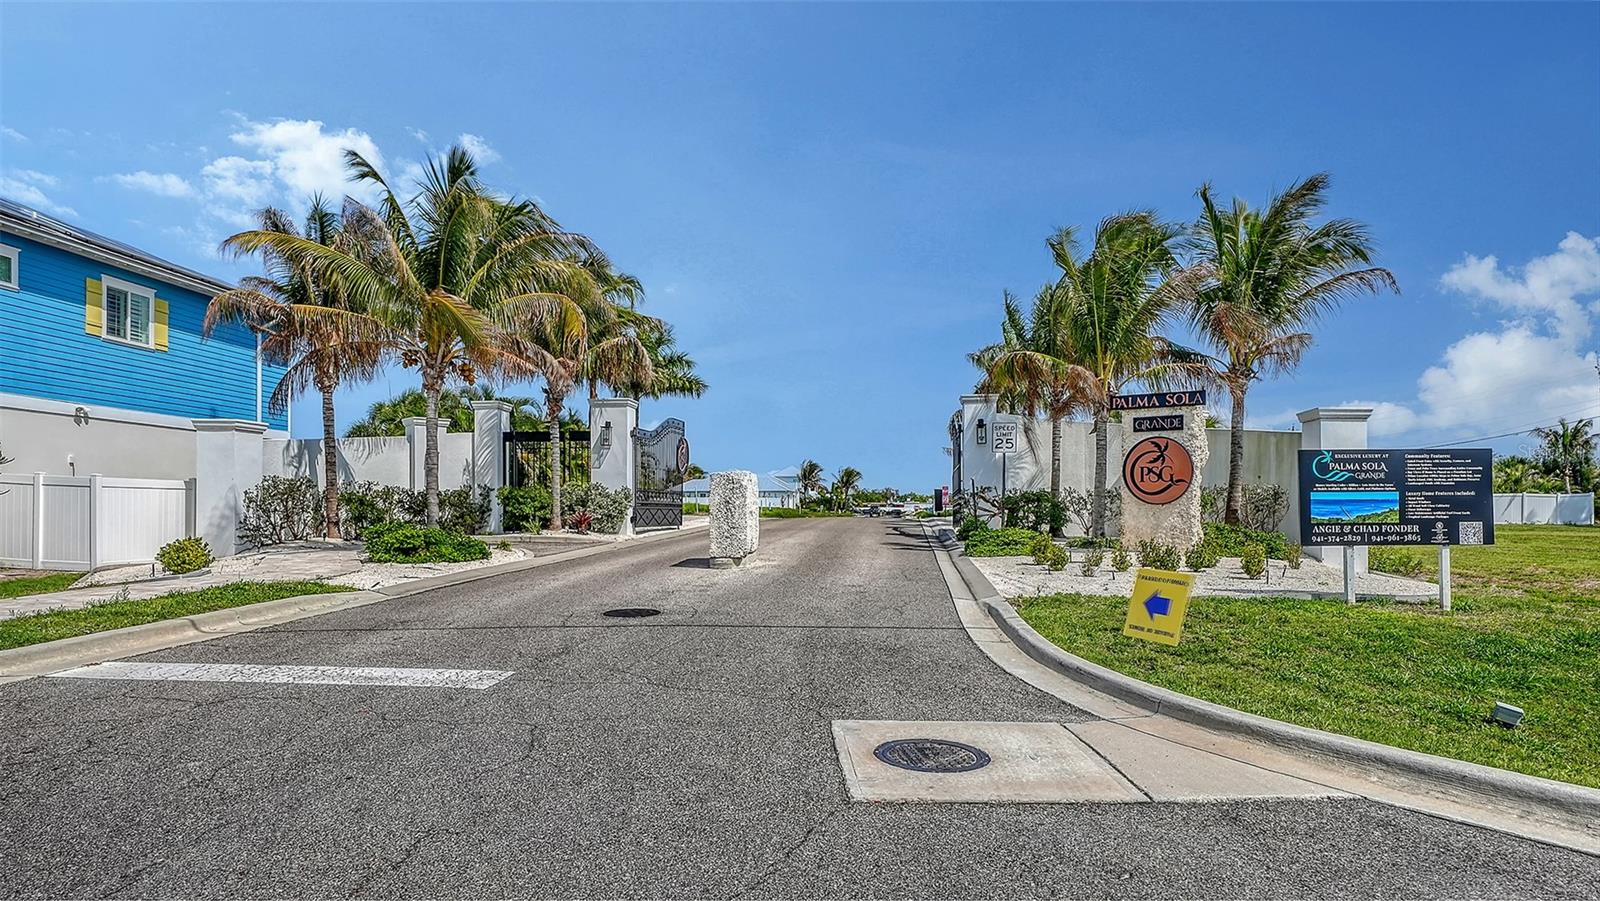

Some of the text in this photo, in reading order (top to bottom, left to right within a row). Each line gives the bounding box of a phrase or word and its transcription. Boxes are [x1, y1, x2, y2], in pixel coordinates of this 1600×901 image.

[1112, 393, 1204, 409] PALMA SOLA
[1134, 417, 1182, 431] GRANDE
[995, 438, 1014, 449] 25
[1329, 461, 1389, 472] PALMA SOLA
[1139, 465, 1178, 486] PSG
[1354, 471, 1386, 480] GRANDE
[1312, 524, 1420, 533] ANGIE & CHAD FONDER
[1311, 534, 1423, 543] 941-374-2829 941-961-3865
